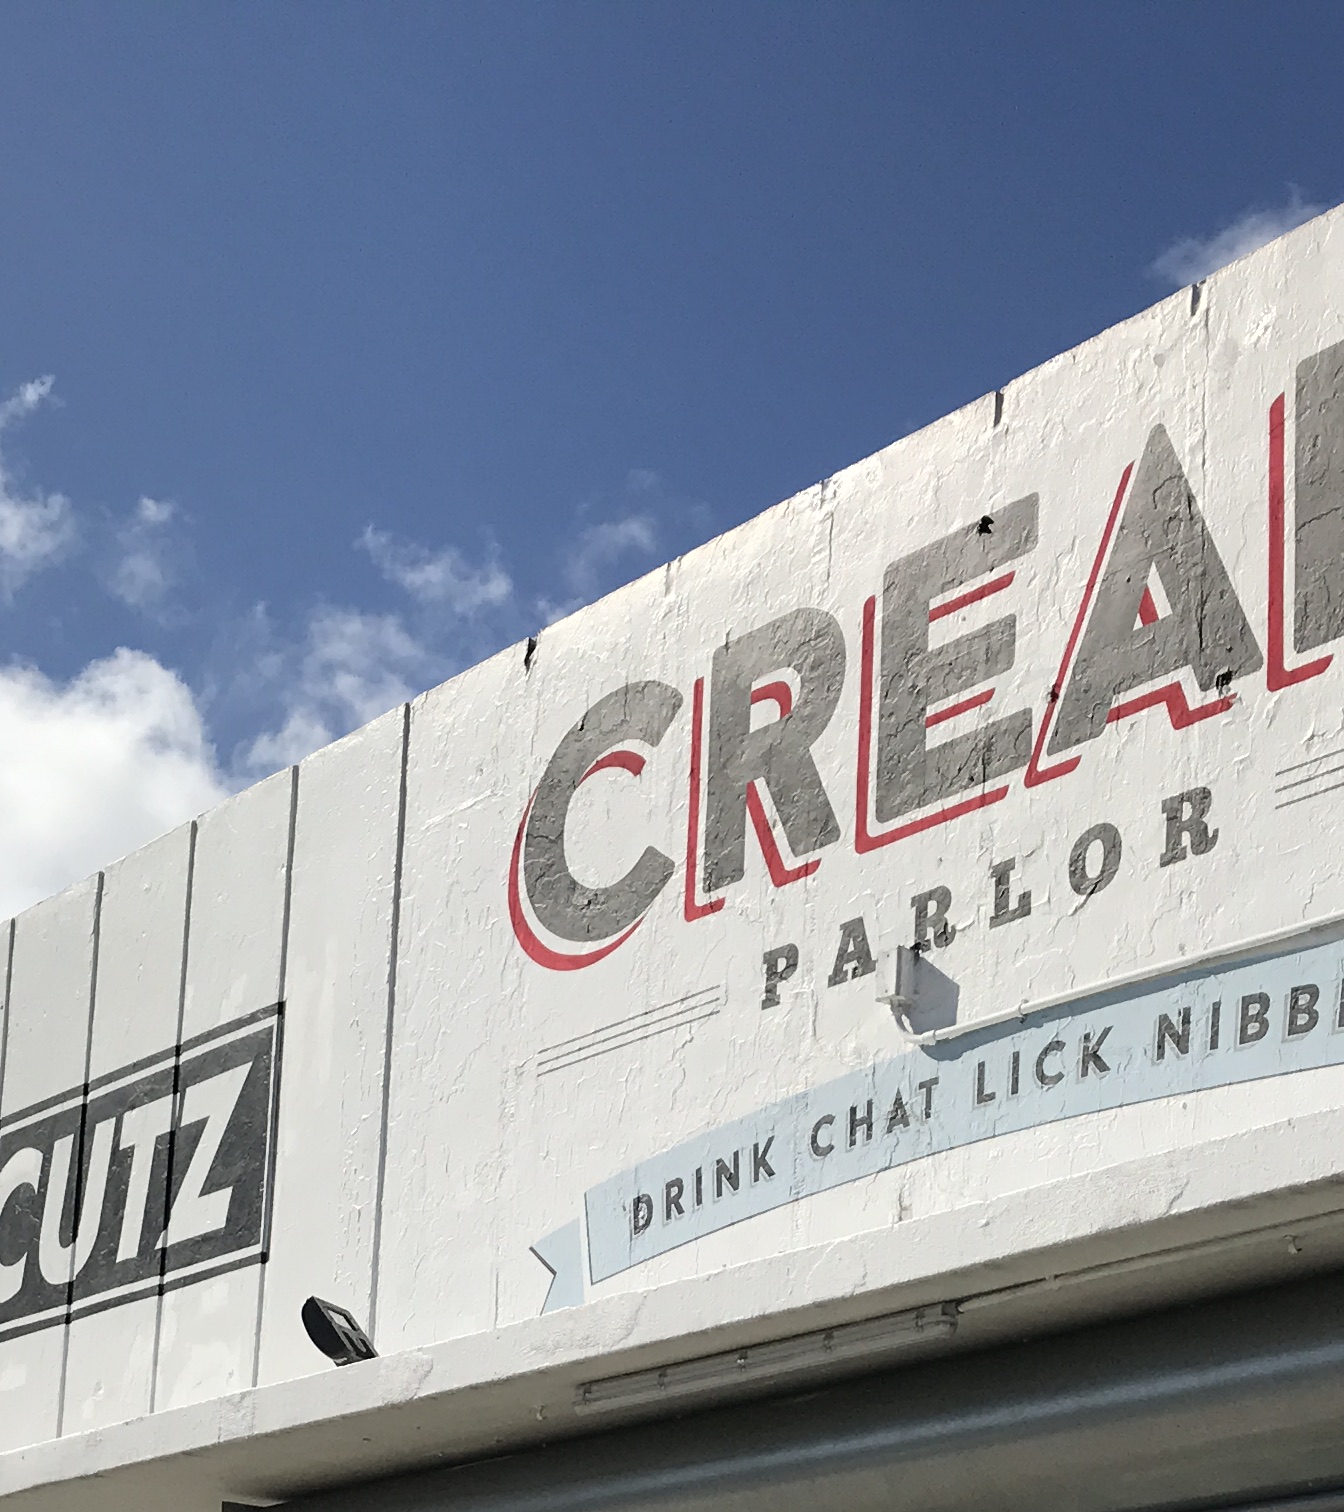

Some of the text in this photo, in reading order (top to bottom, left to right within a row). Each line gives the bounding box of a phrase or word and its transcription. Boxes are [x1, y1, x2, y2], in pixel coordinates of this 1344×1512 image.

[762, 784, 1218, 1010] PARLOR
[630, 1135, 777, 1236] DRINK
[809, 1080, 938, 1157] CHAT
[974, 1025, 1112, 1106] LICK
